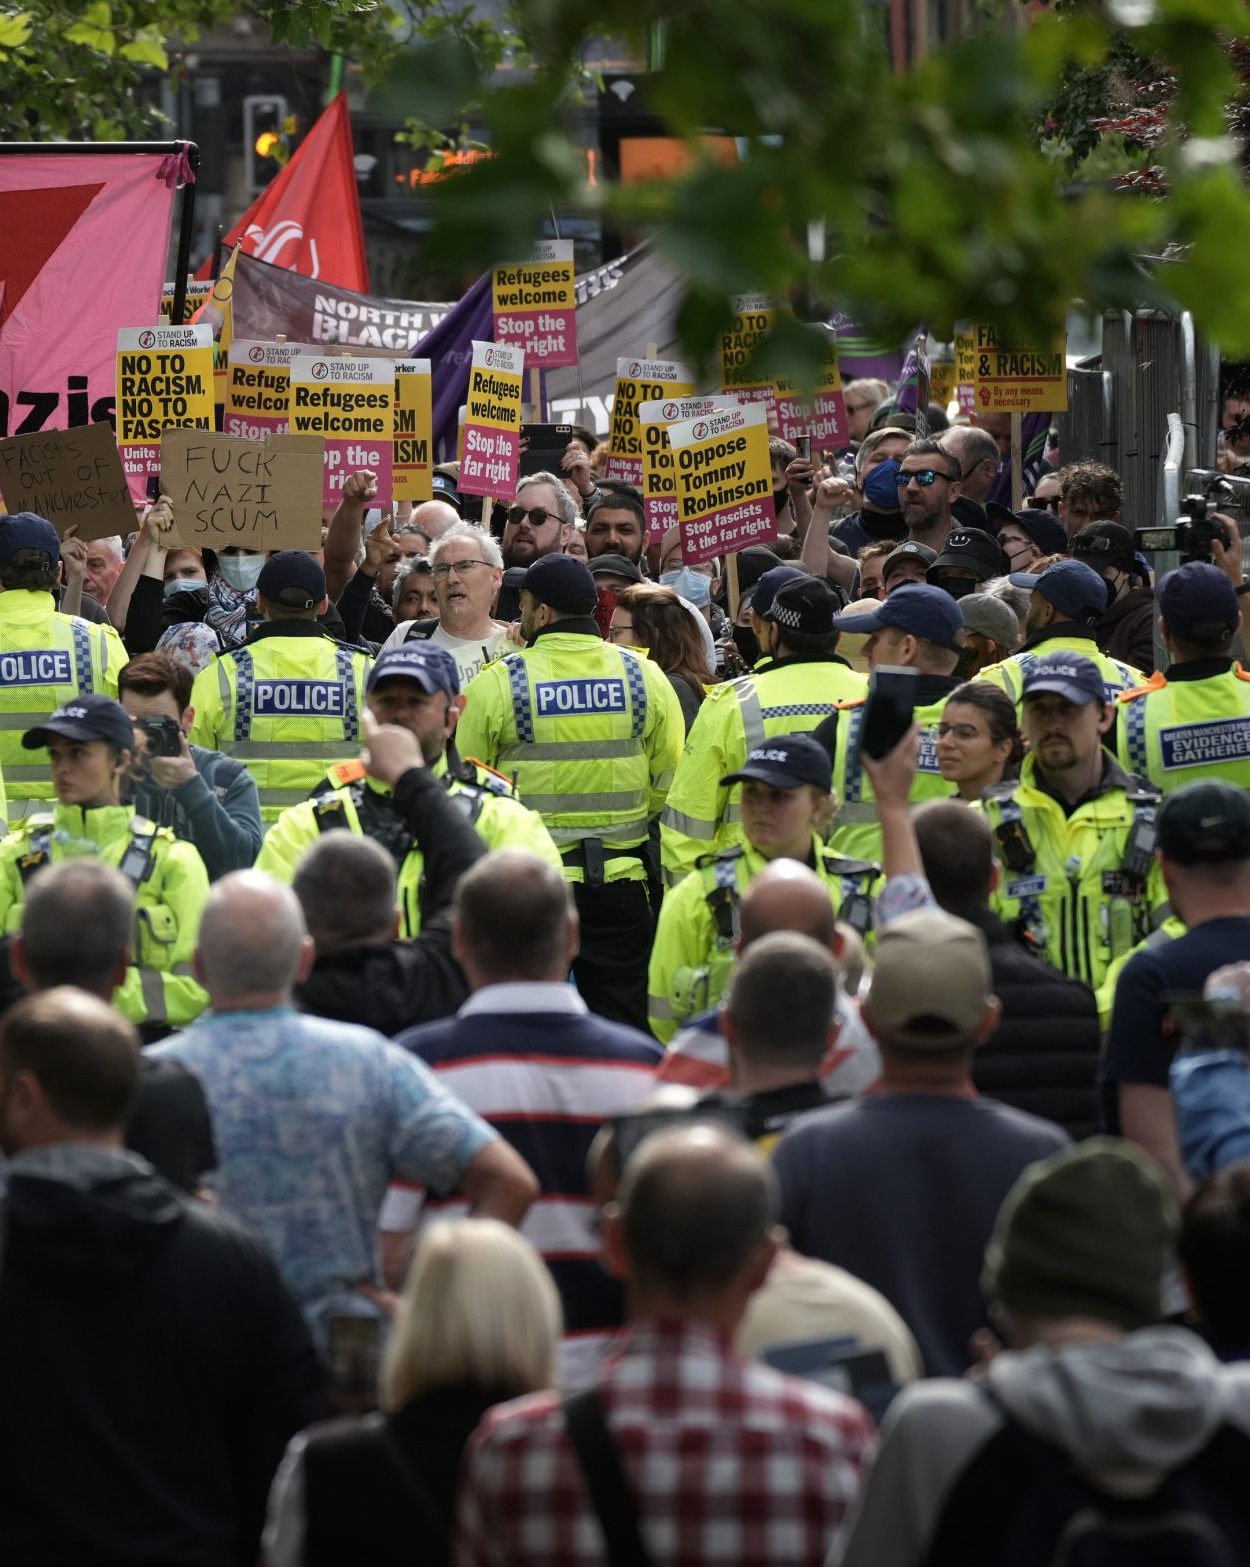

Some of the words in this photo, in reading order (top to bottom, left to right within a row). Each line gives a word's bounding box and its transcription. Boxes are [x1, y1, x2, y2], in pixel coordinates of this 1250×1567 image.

[497, 269, 570, 287] Refugees
[497, 288, 567, 306] welcome
[314, 294, 422, 328] NORTH
[497, 316, 534, 336] Stop
[537, 314, 565, 331] the
[746, 315, 767, 331] TO
[157, 331, 182, 339] STAND
[183, 330, 194, 338] UP
[158, 340, 168, 348] TO
[169, 338, 198, 348] RACISM
[265, 348, 290, 356] STAND
[526, 336, 565, 356] right
[121, 355, 152, 376] NO
[157, 354, 185, 374] TO
[266, 356, 276, 364] TO
[330, 362, 356, 371] STAND
[358, 363, 370, 372] UP
[643, 364, 664, 372] STAND
[723, 350, 745, 367] NO
[978, 354, 991, 376] &
[997, 353, 1062, 376] RACISM
[330, 371, 341, 380] TO
[342, 372, 373, 381] RACISM
[473, 371, 520, 400] Refugees
[652, 372, 677, 380] RACISM
[121, 375, 205, 398] RACISM,
[617, 382, 636, 399] NO
[641, 384, 663, 400] TO
[994, 386, 1003, 397] By
[1005, 388, 1018, 397] any
[1020, 387, 1043, 395] means
[122, 397, 153, 418] NO
[159, 397, 187, 417] TO
[295, 386, 389, 412] Refugees
[680, 402, 700, 411] STAND
[703, 401, 714, 410] UP
[779, 402, 811, 420] Stop
[814, 398, 836, 415] the
[994, 398, 1031, 408] necessary
[471, 400, 516, 423] welcome
[681, 410, 690, 418] TO
[709, 416, 730, 427] STAND
[731, 411, 741, 420] UP
[295, 412, 384, 433] welcome
[613, 418, 633, 435] NO
[710, 426, 719, 434] TO
[720, 418, 745, 432] RACISM
[782, 422, 803, 440] far
[806, 417, 839, 440] right
[124, 447, 155, 459] Unite
[466, 430, 494, 457] Stop
[495, 436, 512, 456] the
[678, 436, 747, 470] Oppose
[186, 446, 277, 477] FUCK
[346, 446, 380, 466] the
[609, 459, 631, 470] Unite
[20, 466, 57, 489] OUT
[76, 457, 110, 481] OF
[124, 461, 143, 473] the
[464, 455, 484, 476] far
[485, 461, 510, 484] right
[680, 460, 746, 493] Tommy
[184, 479, 272, 504] NAZI
[683, 477, 768, 517] Robinson
[194, 507, 279, 533] SCUM
[650, 517, 661, 530] &
[685, 518, 713, 537] Stop
[714, 503, 762, 526] fascists
[686, 540, 697, 553] &
[699, 533, 718, 546] the
[720, 528, 739, 541] far
[740, 517, 771, 536] right
[382, 652, 427, 666] POLICE
[1033, 664, 1078, 677] POLICE
[257, 684, 341, 711] POLICE
[539, 681, 623, 711] POLICE
[1163, 729, 1192, 742] GREATER
[1193, 724, 1235, 738] MANCHESTER
[1172, 731, 1250, 751] EVIDENCE
